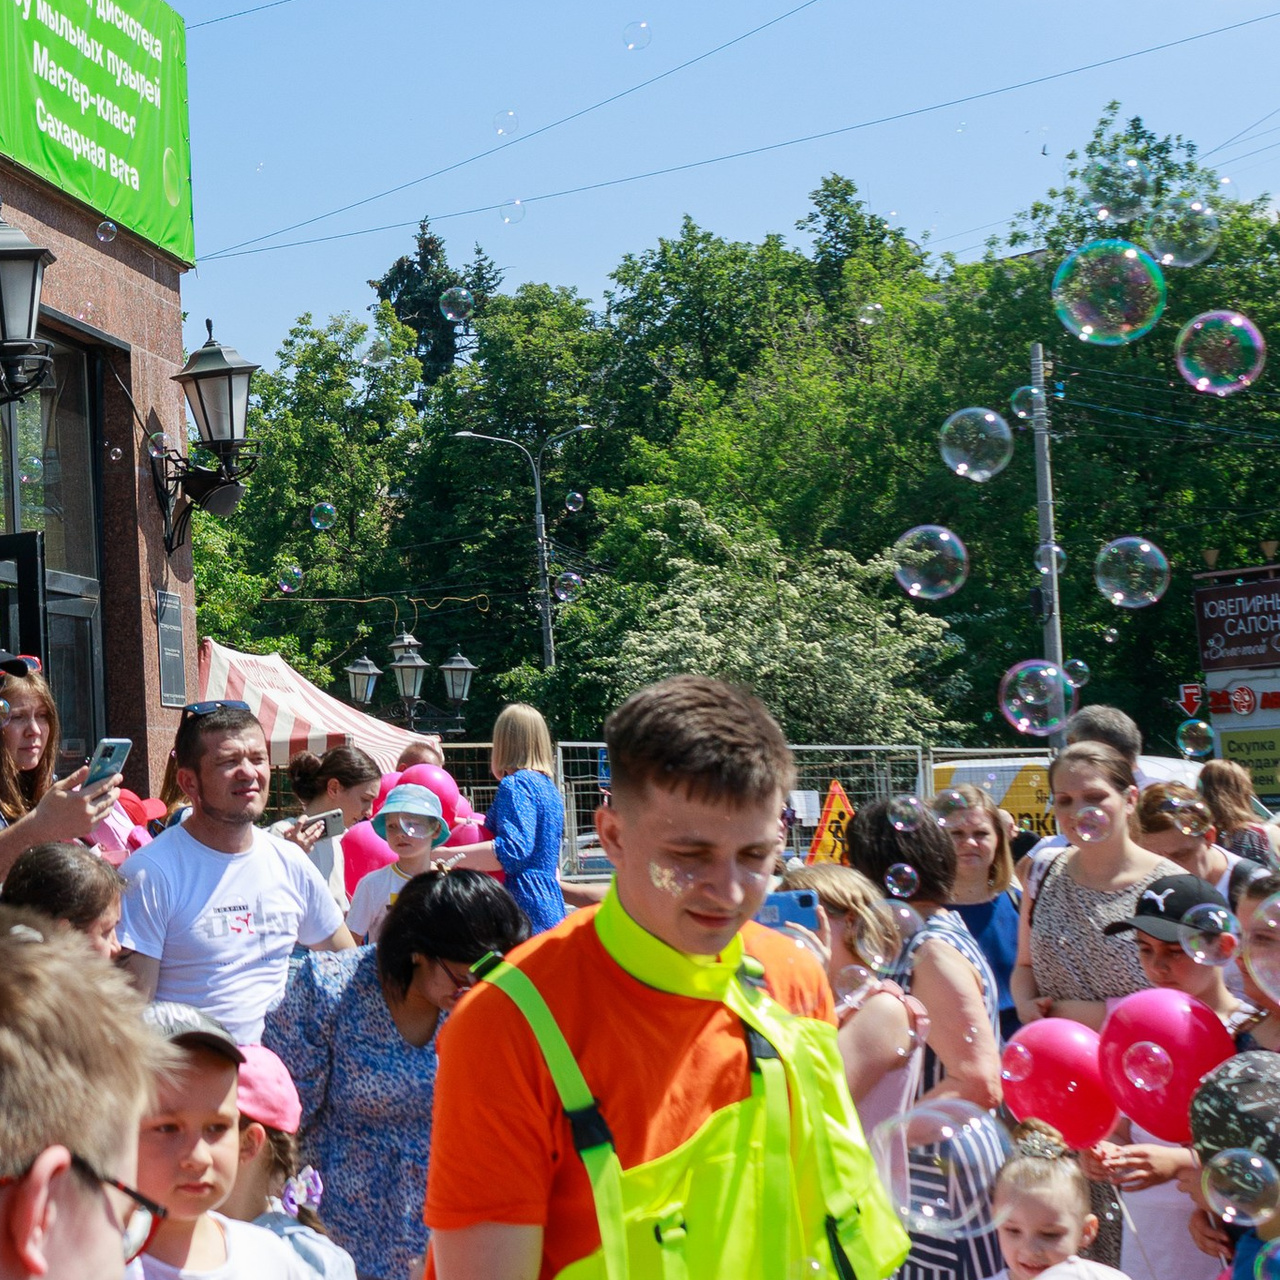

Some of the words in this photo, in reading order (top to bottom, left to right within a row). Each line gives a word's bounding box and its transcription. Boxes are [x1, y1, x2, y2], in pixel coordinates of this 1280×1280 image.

[32, 39, 137, 140] Мастер-класс
[106, 47, 161, 110] пузырей
[35, 97, 106, 171] Сахарная
[109, 150, 140, 192] вата
[1224, 613, 1280, 636] САЛОН
[1227, 739, 1276, 755] Скупка
